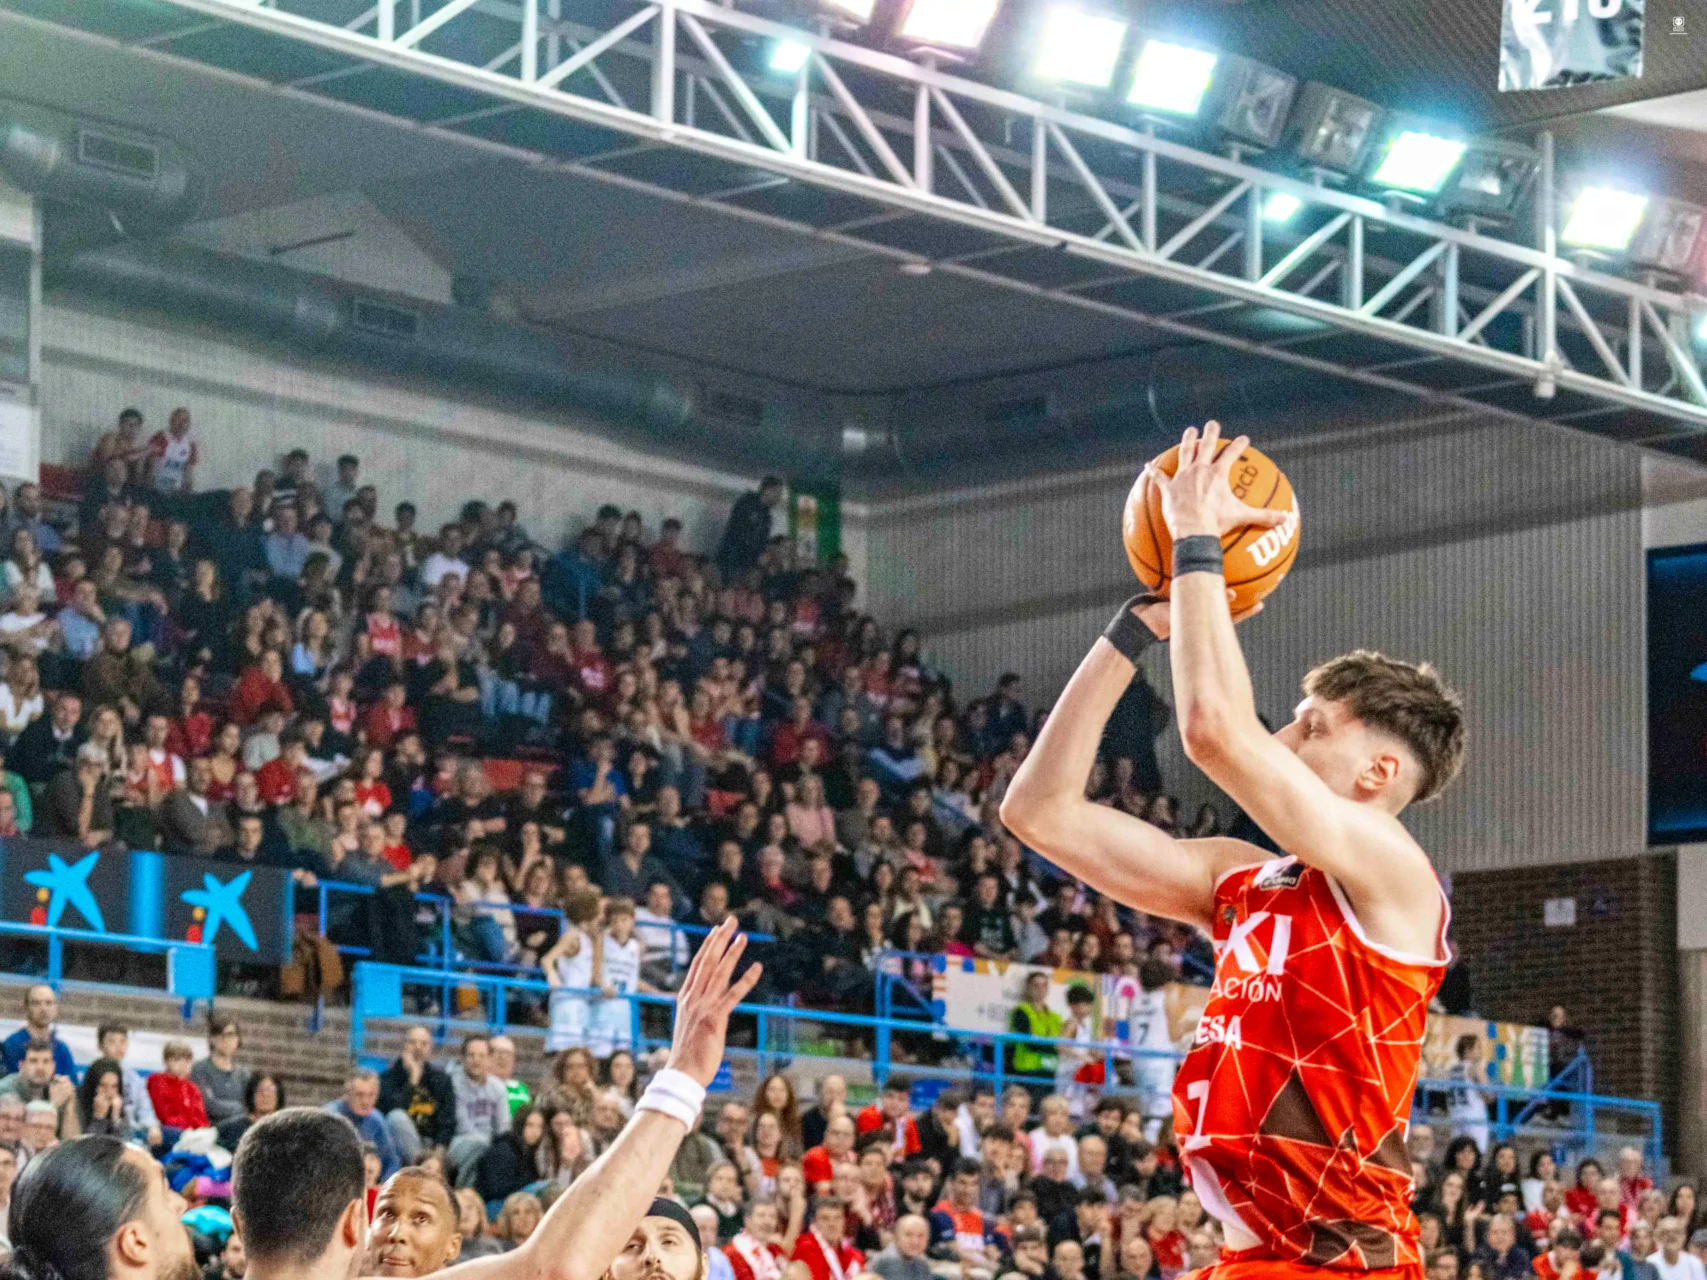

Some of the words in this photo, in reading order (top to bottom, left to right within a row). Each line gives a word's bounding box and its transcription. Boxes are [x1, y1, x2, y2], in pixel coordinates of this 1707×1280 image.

[1212, 911, 1292, 976] XI
[1210, 974, 1282, 1003] ACIÓN
[1197, 1015, 1242, 1050] ESA
